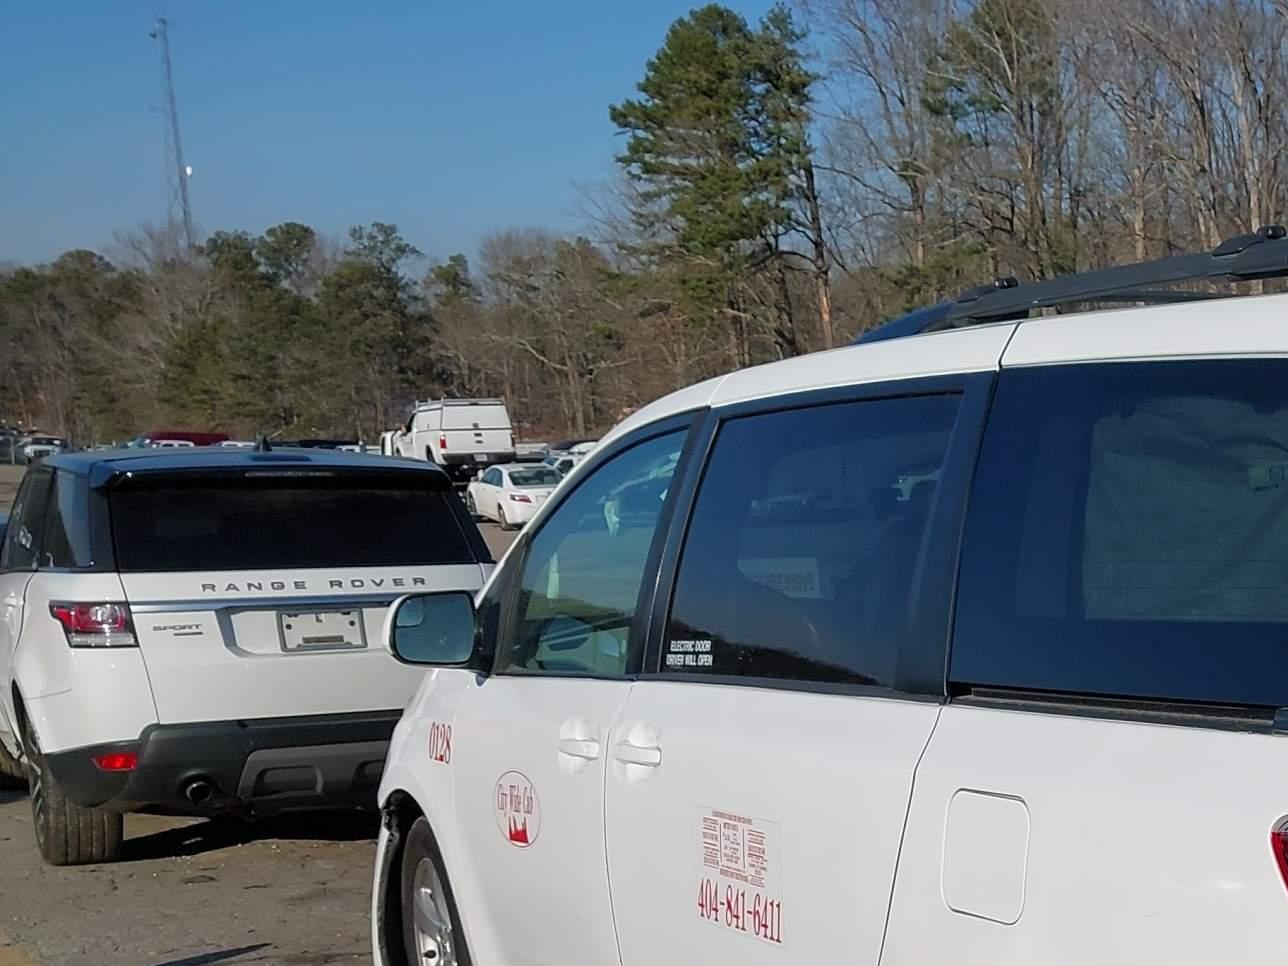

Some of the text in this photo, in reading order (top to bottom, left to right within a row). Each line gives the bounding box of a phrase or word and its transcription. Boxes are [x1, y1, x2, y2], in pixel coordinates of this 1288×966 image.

[201, 576, 428, 593] RANGE ROVER
[152, 623, 202, 631] SPORT
[670, 640, 712, 652] ELECTRIC DOOR
[666, 654, 713, 666] DRIVER WILL OPEN
[429, 721, 452, 764] 0128
[698, 878, 782, 944] 404-841-6411
